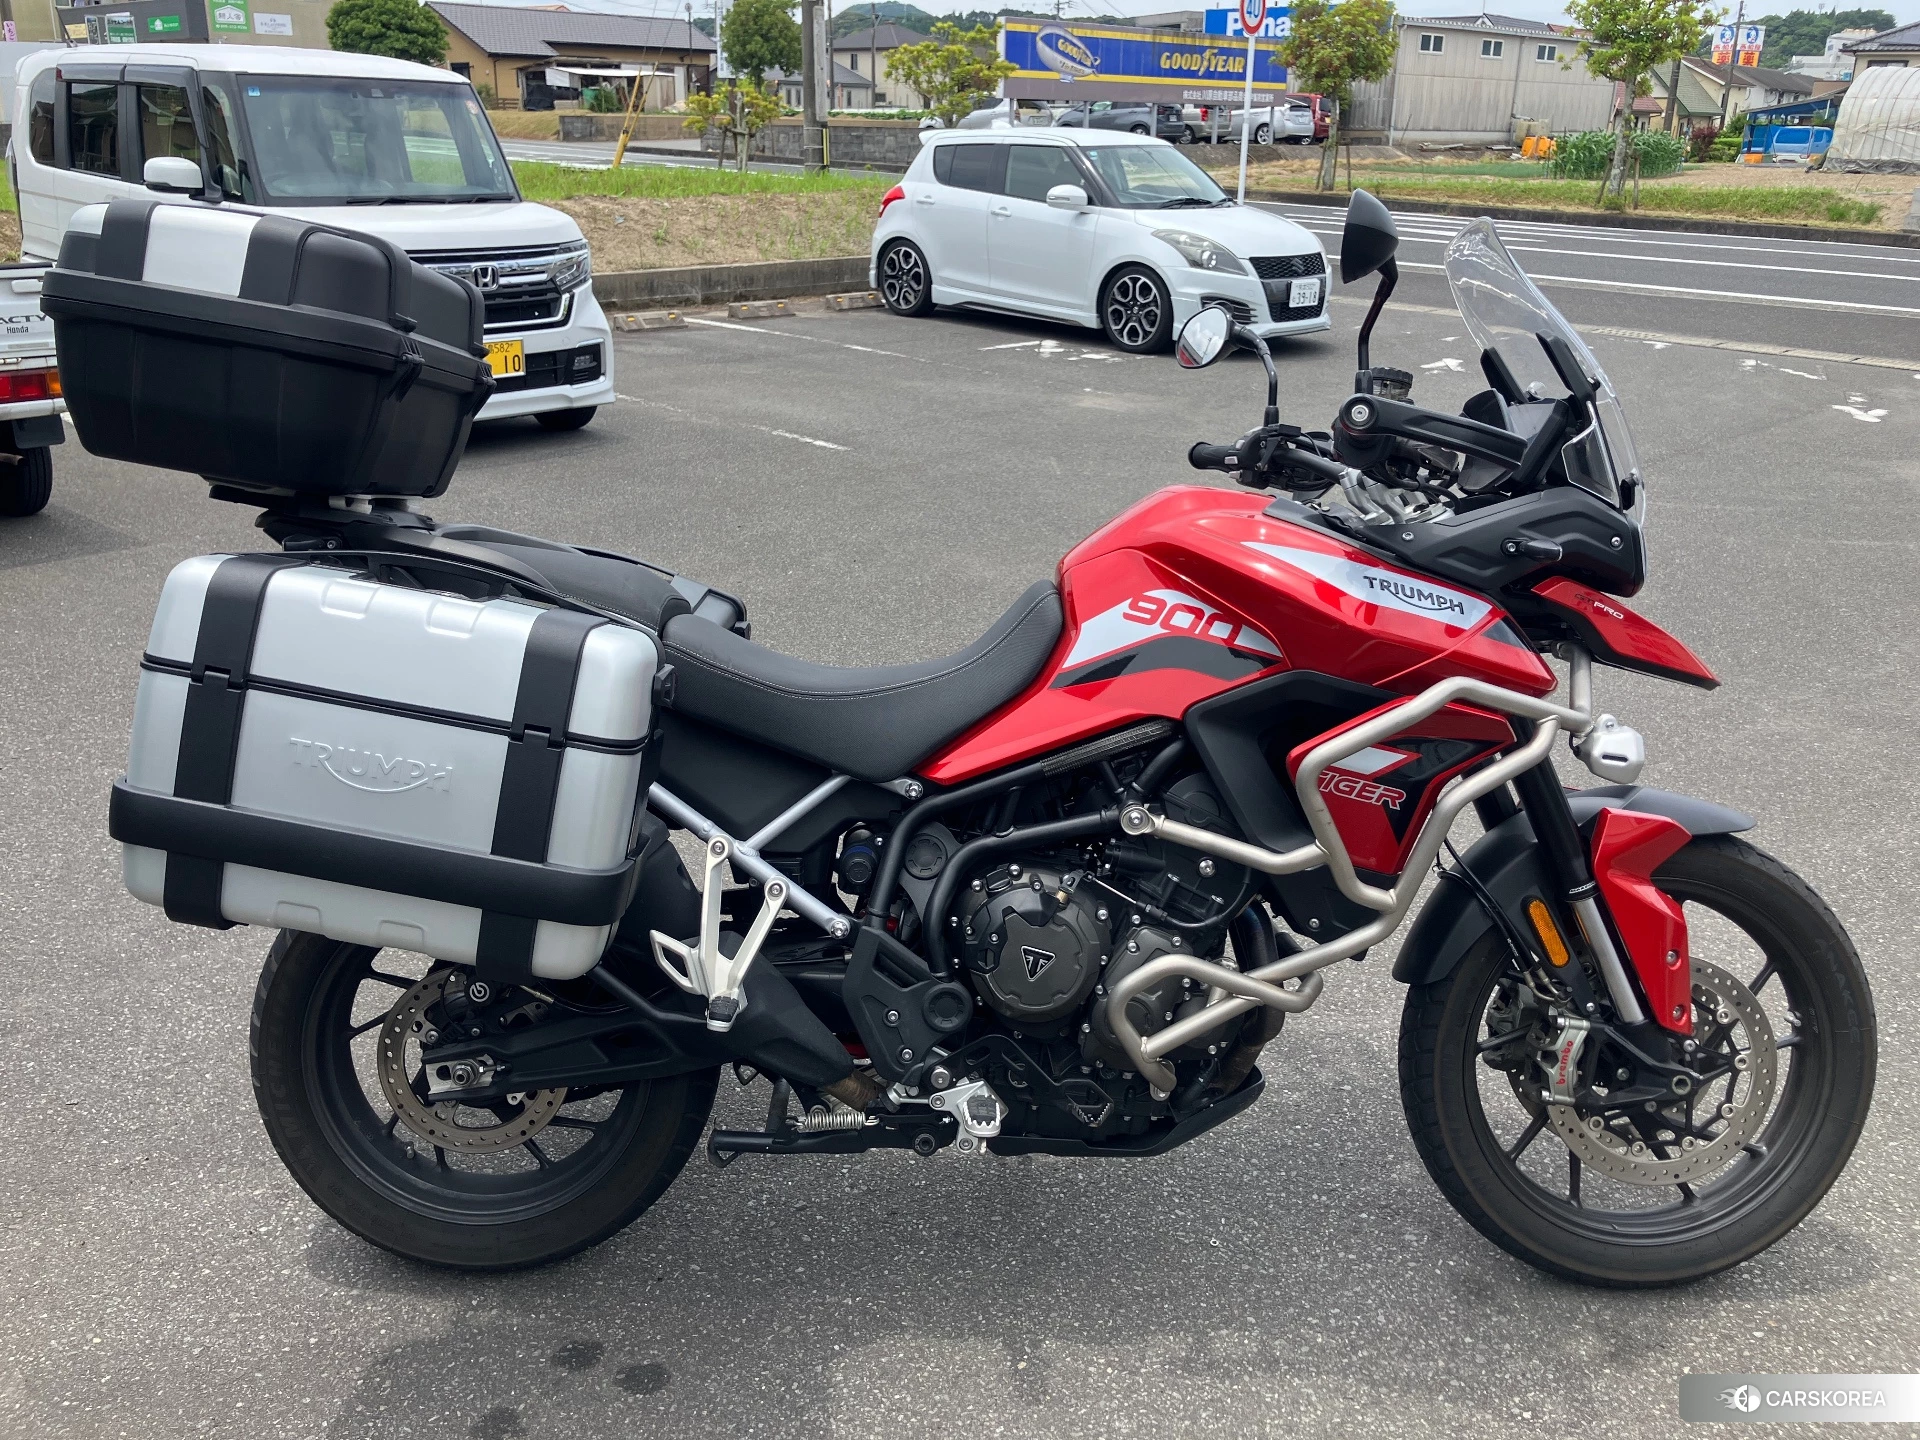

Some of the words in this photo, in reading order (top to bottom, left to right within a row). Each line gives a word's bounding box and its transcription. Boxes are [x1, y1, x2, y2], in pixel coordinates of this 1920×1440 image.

[1226, 11, 1292, 37] Pna
[1160, 49, 1245, 75] GOODYEAR
[1296, 291, 1317, 305] 39-18
[6, 325, 29, 334] Honda
[504, 354, 521, 374] 10
[1363, 575, 1465, 615] TRIUMPH
[1122, 594, 1242, 646] 900
[1593, 601, 1624, 620] PRO
[289, 737, 453, 794] TRIUMPH
[1319, 770, 1407, 811] IGER
[1555, 1040, 1574, 1085] brembo
